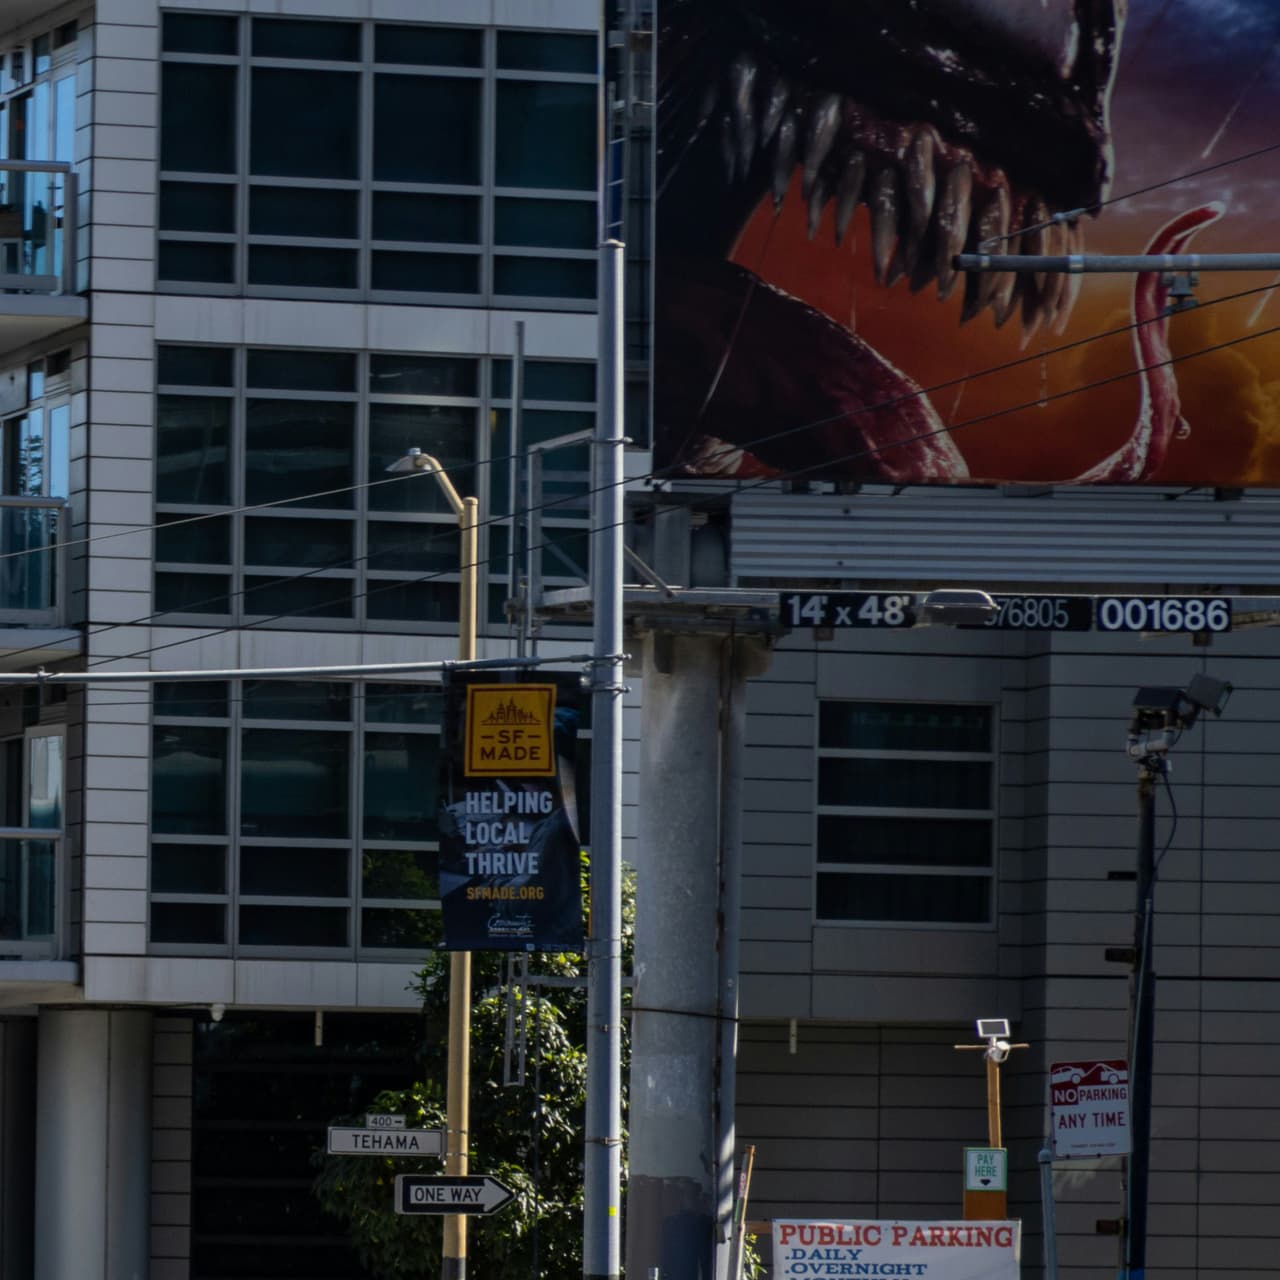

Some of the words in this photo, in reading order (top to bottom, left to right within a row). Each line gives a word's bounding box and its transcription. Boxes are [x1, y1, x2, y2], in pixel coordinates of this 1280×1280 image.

[788, 595, 828, 625] 14'
[857, 595, 910, 625] 48'
[1100, 598, 1229, 630] 001686
[497, 729, 525, 745] SF
[479, 745, 541, 761] MADE
[465, 791, 553, 815] HELPING
[465, 821, 530, 845] LOCAL
[465, 852, 539, 875] THRIVE
[466, 885, 545, 900] SFMADE.ORG
[1054, 1088, 1077, 1103] NO
[1079, 1087, 1128, 1101] PARKING
[371, 1116, 391, 1127] 400
[1058, 1112, 1087, 1129] ANY
[1091, 1111, 1127, 1127] TIME
[351, 1134, 420, 1150] TEHAMA
[977, 1153, 994, 1165] PAY
[975, 1165, 998, 1176] HERE
[414, 1187, 445, 1202] ONE
[449, 1187, 483, 1202] WAY
[779, 1224, 881, 1246] PUBLIC
[891, 1225, 1013, 1247] PARKING
